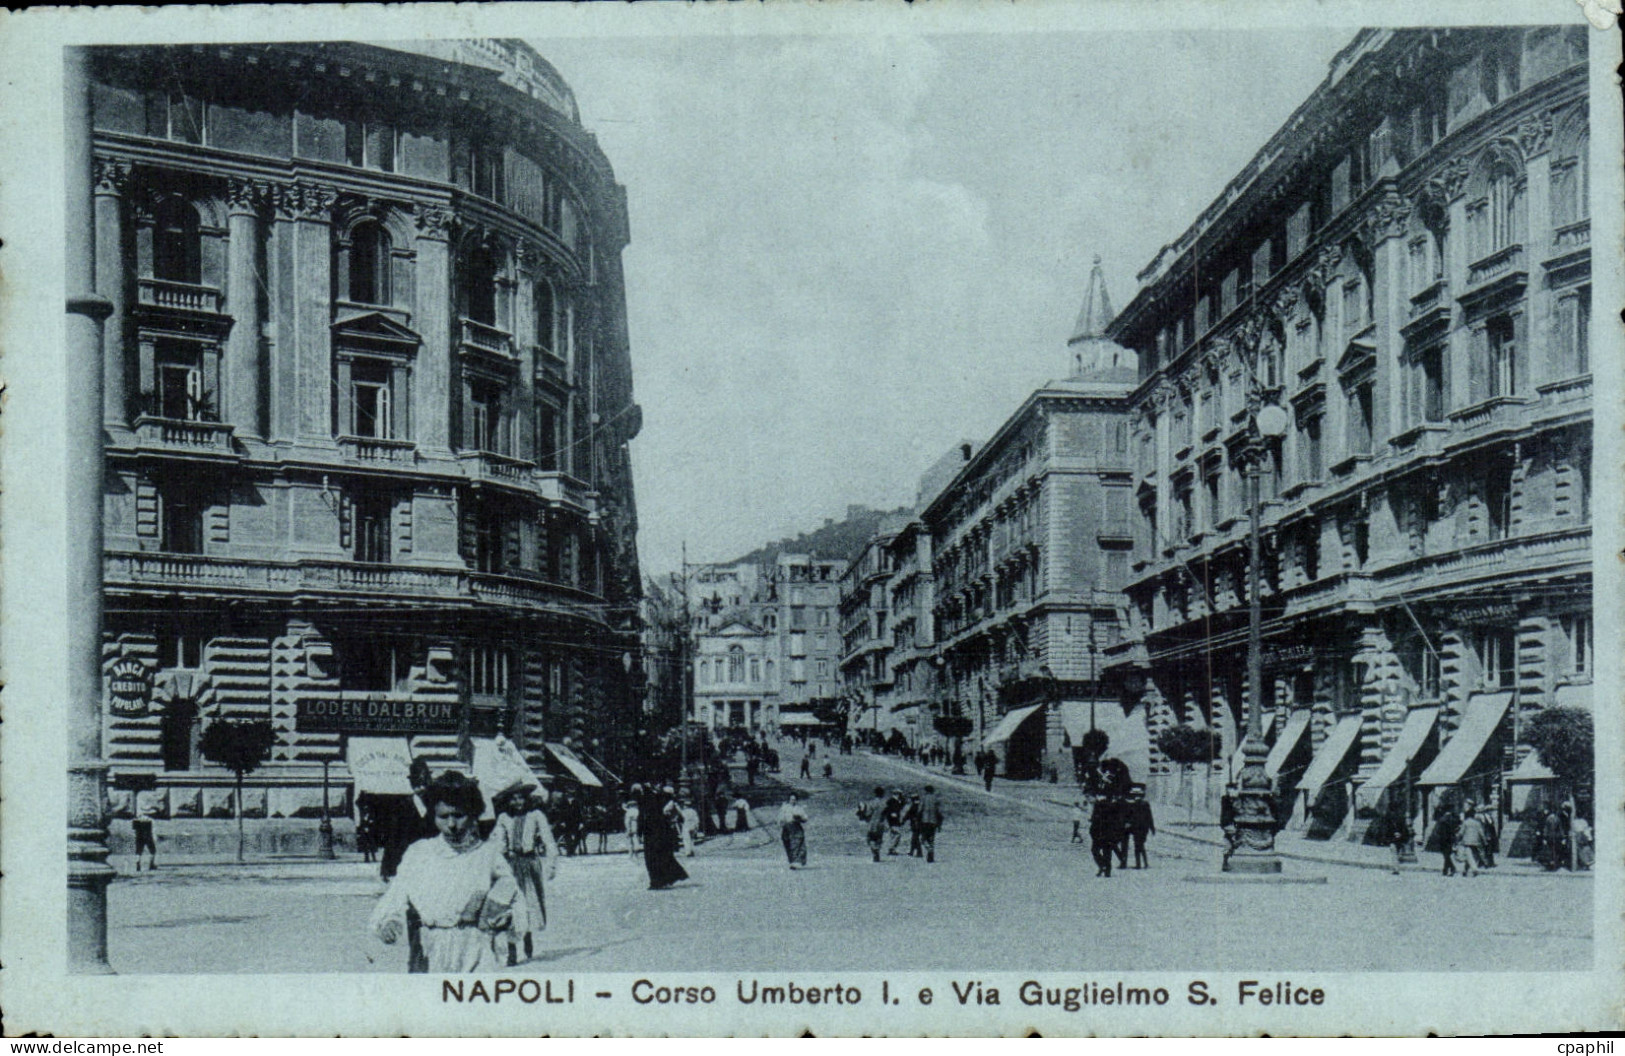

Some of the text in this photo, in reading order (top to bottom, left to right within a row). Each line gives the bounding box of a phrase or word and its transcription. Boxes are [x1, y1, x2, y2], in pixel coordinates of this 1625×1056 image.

[112, 662, 145, 678] BANCA
[111, 681, 147, 693] CREDITO
[111, 695, 147, 711] POPOLARE
[306, 700, 362, 717] LODEN
[442, 979, 574, 1004] NAPOLI
[631, 979, 716, 1005] Corso
[737, 980, 862, 1005] Umberto
[882, 980, 899, 1005] I.
[918, 987, 933, 1006] e
[951, 980, 1001, 1005] Via
[1019, 980, 1170, 1012] Guglielmo
[1187, 980, 1217, 1006] S.
[1238, 980, 1325, 1006] Felice
